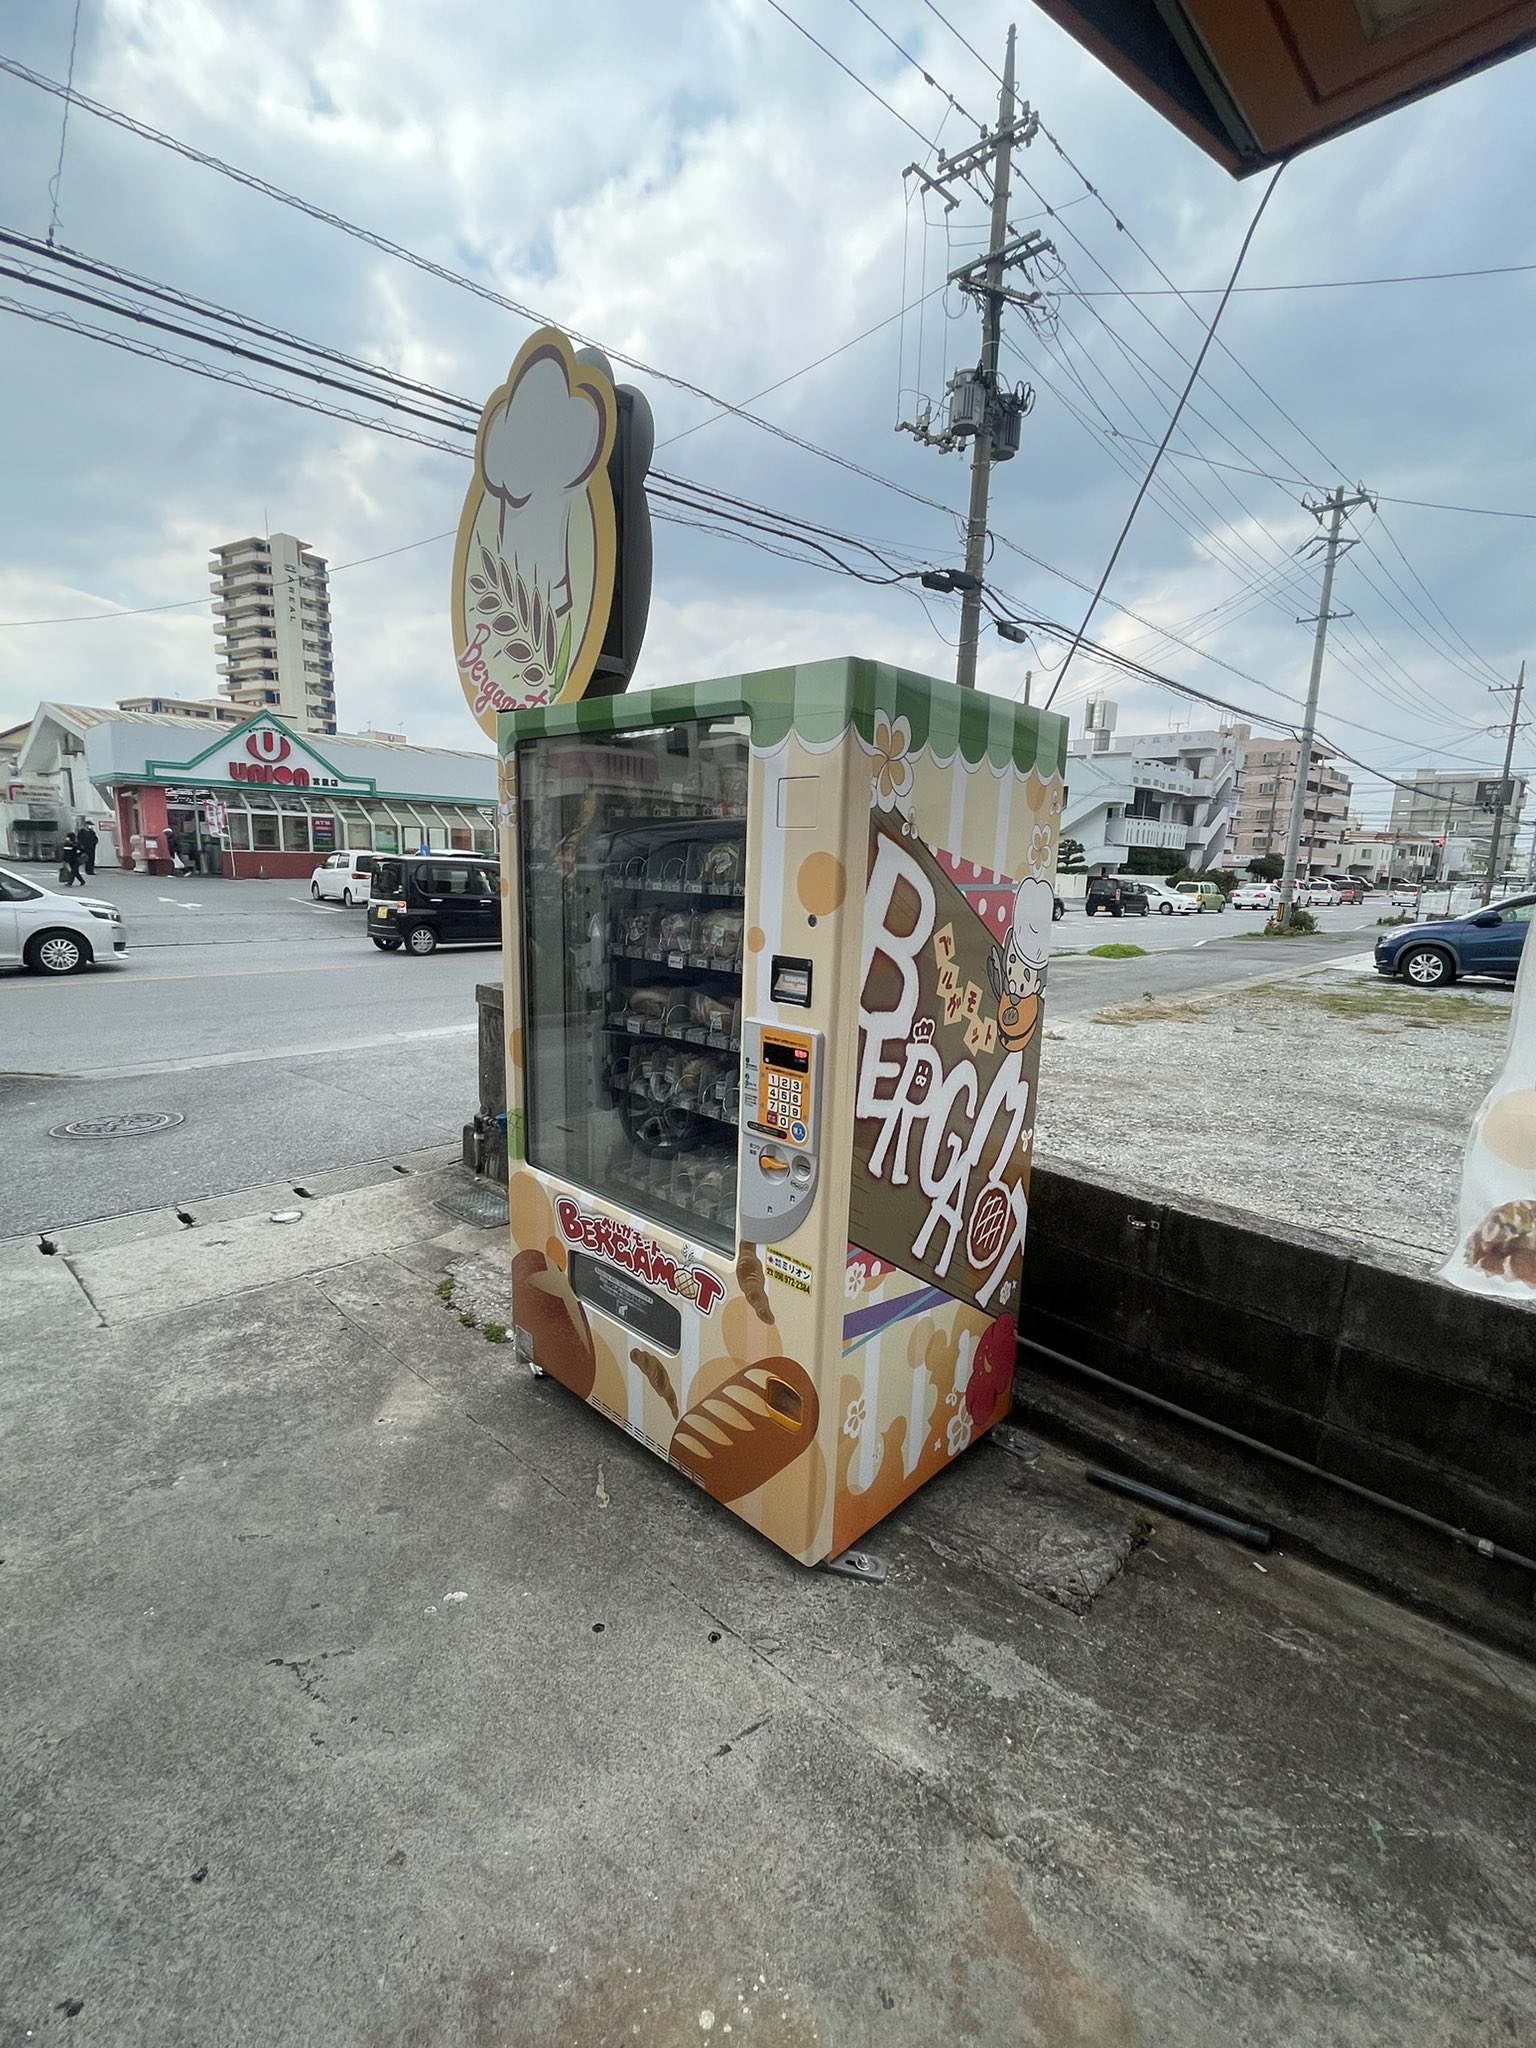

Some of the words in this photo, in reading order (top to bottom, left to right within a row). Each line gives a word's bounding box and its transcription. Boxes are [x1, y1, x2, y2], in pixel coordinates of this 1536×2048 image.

[781, 1078, 788, 1087] 2
[793, 1081, 800, 1090] 3
[769, 1088, 776, 1097] 4
[781, 1091, 787, 1100] 5
[792, 1095, 799, 1103] 6
[770, 1101, 776, 1110] 7
[781, 1104, 787, 1113] 8
[792, 1107, 799, 1116] 9
[780, 1117, 787, 1126] 0
[557, 1199, 723, 1312] BERGAMOT
[782, 1261, 811, 1279] ミリオン
